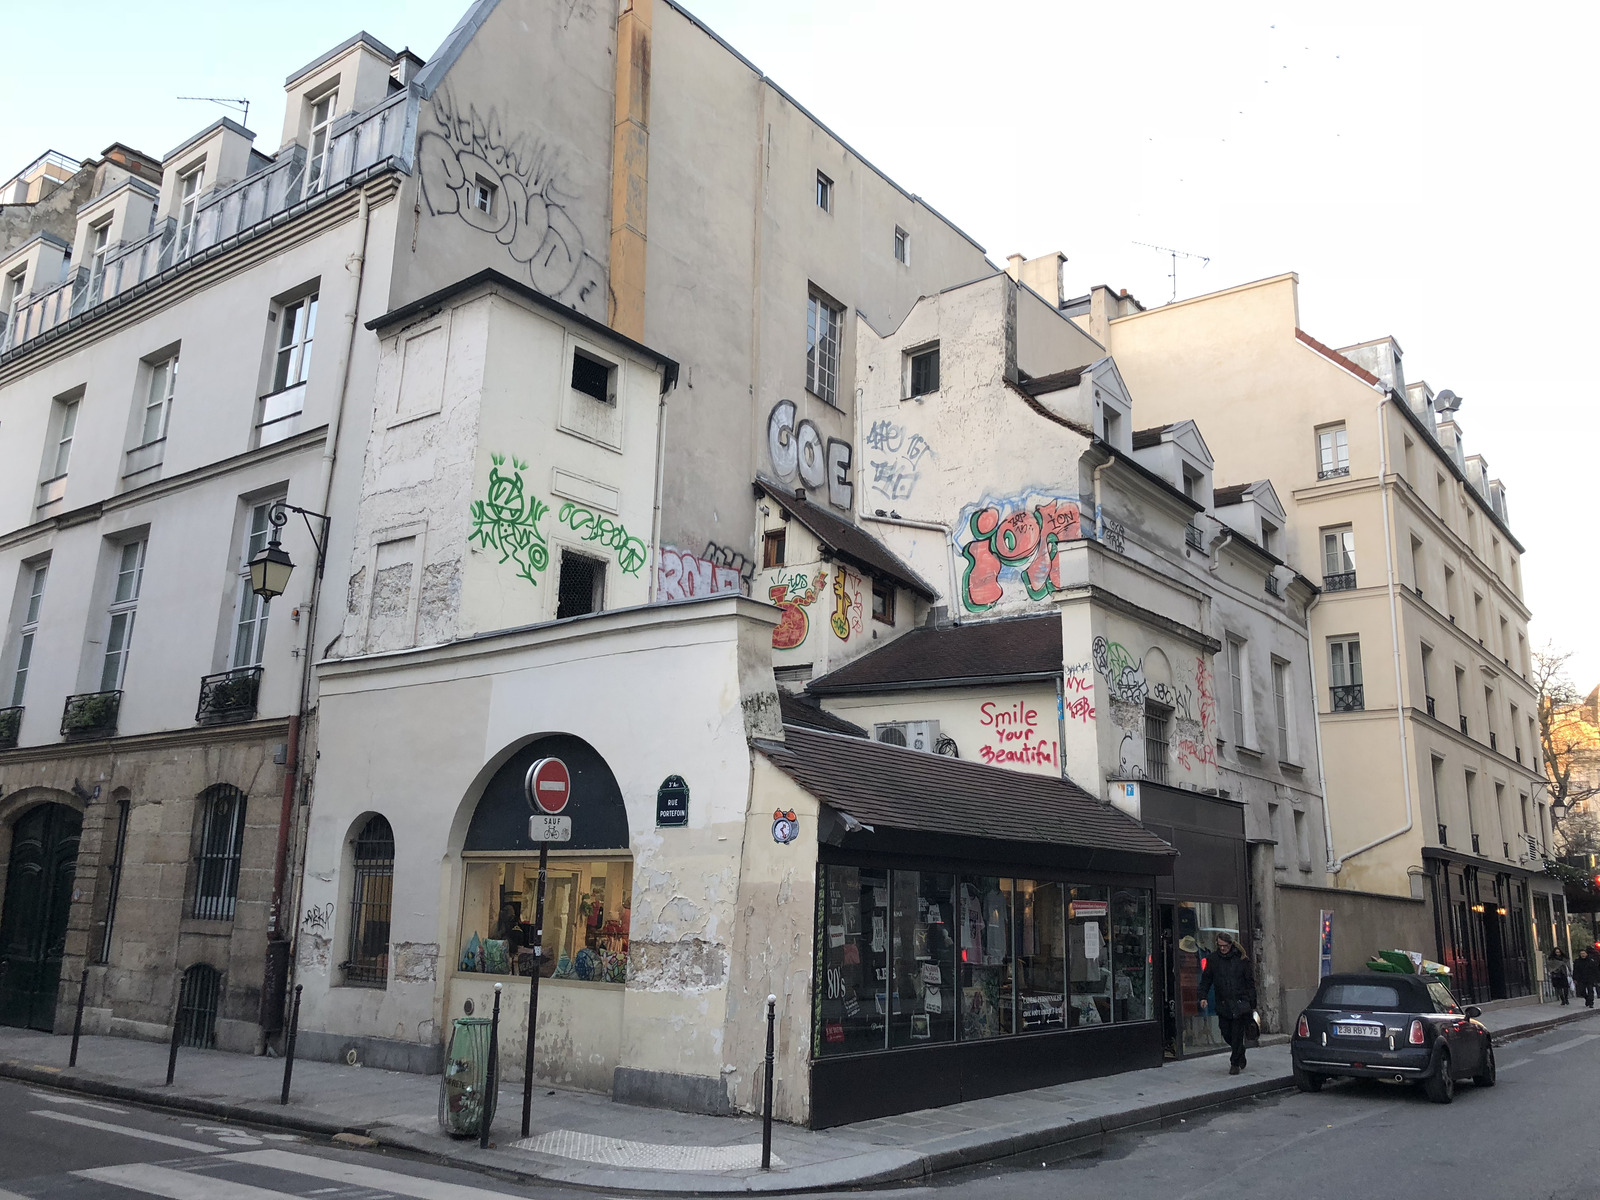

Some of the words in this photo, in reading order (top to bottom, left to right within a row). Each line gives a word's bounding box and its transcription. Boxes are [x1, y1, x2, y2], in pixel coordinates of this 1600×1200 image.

[1066, 676, 1094, 693] NYC
[980, 700, 1038, 728] Smile
[979, 739, 1058, 768] Beautiful
[544, 817, 561, 825] SAUF
[660, 809, 685, 818] PORTEFOIN
[827, 966, 846, 999] 80's
[1338, 1025, 1351, 1034] 238
[1353, 1026, 1366, 1035] RBY
[1368, 1028, 1379, 1036] 75
